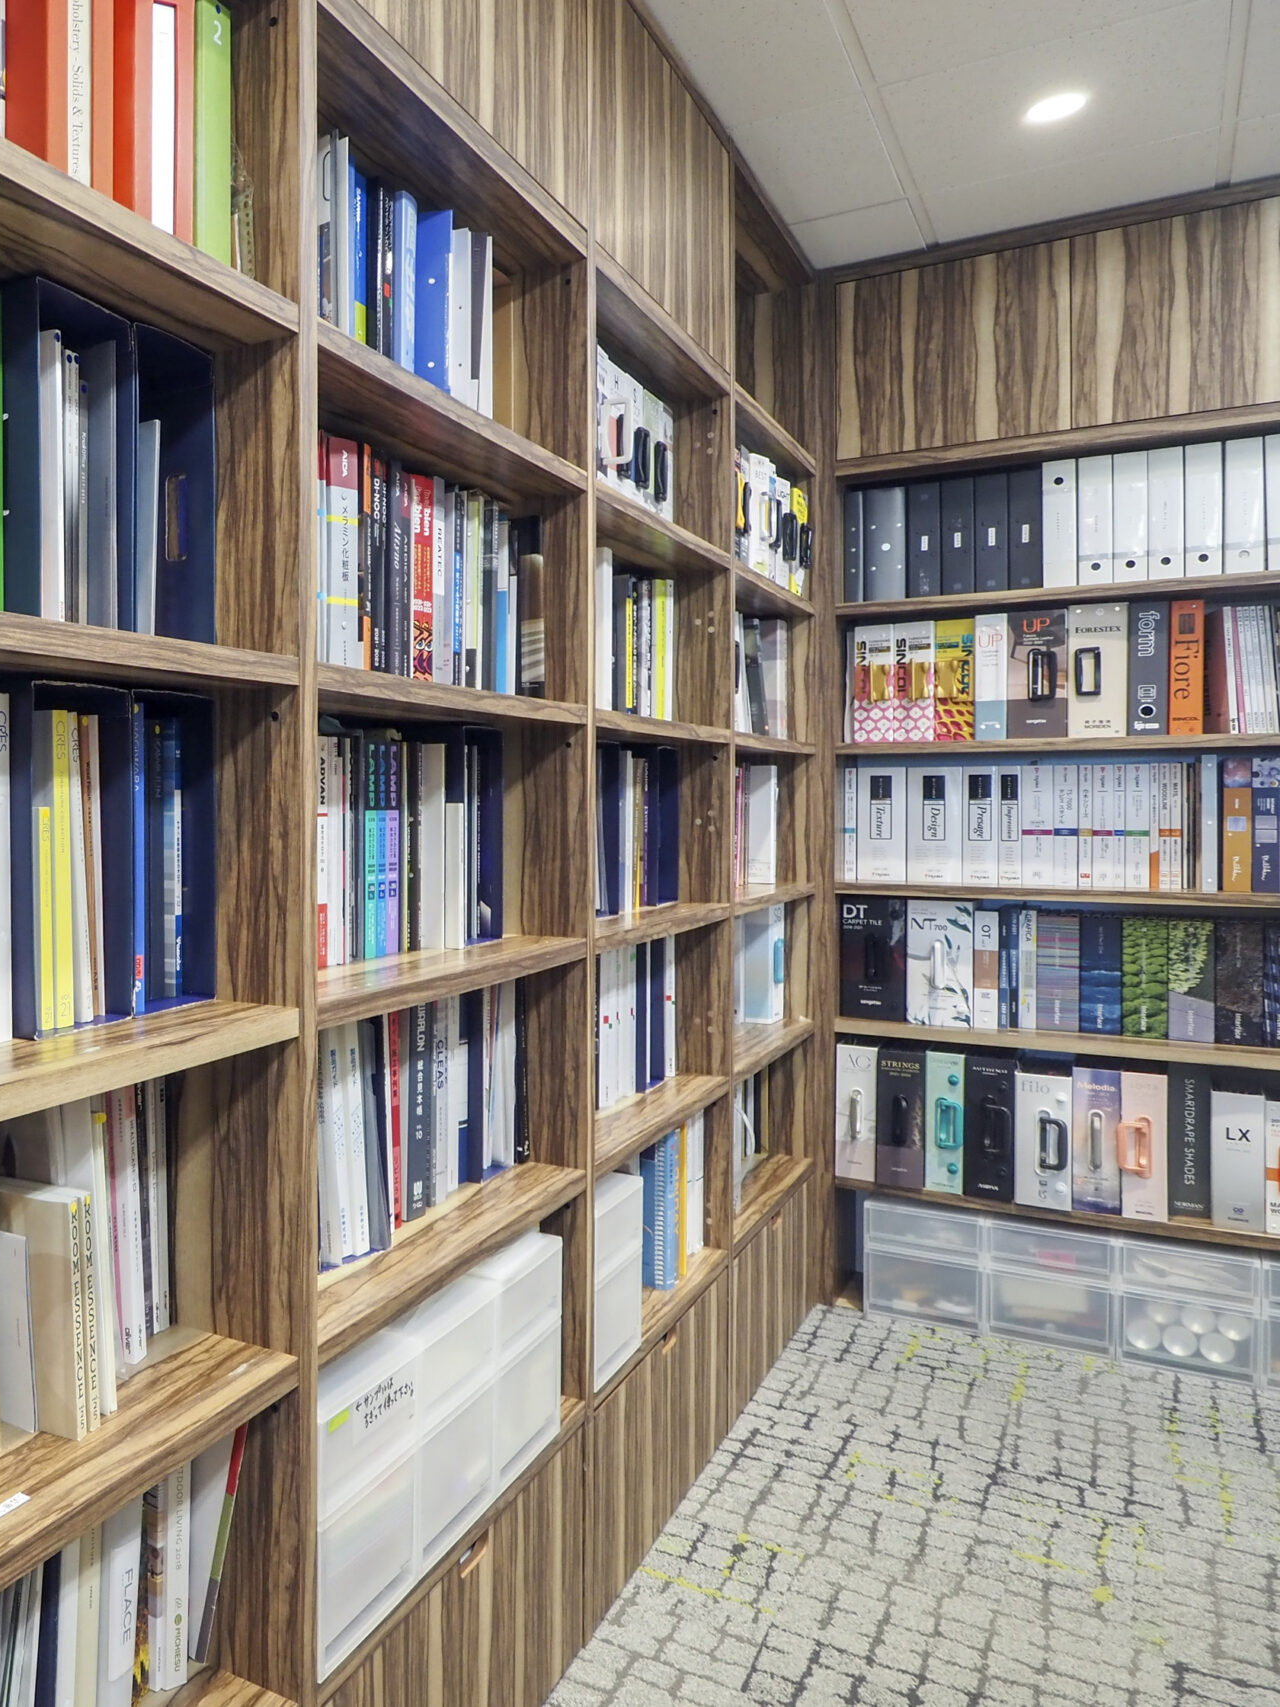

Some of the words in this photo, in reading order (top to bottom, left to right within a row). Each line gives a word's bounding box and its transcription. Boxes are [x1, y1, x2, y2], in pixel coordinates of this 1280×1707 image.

[212, 20, 223, 46] 2
[72, 64, 84, 103] Solids
[72, 106, 84, 117] &
[72, 121, 84, 175] Textures
[393, 521, 402, 570] Altyno
[978, 633, 1003, 649] UP
[1022, 617, 1050, 633] UP
[1074, 625, 1121, 634] FORESTEX
[1137, 610, 1160, 657] form
[1174, 639, 1200, 700] Fiore
[56, 720, 66, 760] CRES
[71, 727, 81, 763] CRES
[378, 744, 386, 808] LAMP
[389, 744, 398, 808] LAMP
[875, 806, 886, 838] Texture
[927, 807, 940, 839] Design
[842, 904, 868, 919] DT
[981, 924, 992, 939] OT
[436, 1039, 445, 1091] CLEAS
[881, 1060, 921, 1070] STRINGS
[1184, 1078, 1195, 1144] SMARTDRAPE
[1225, 1127, 1251, 1143] LX
[1184, 1147, 1195, 1186] SHADES
[71, 1209, 80, 1275] ROOM
[84, 1202, 94, 1269] ROOM
[74, 1280, 84, 1400] ESSENCE
[86, 1273, 97, 1392] ESSENCE
[175, 1509, 183, 1545] LIVING
[175, 1546, 183, 1571] 2018
[122, 1567, 134, 1646] FLACE
